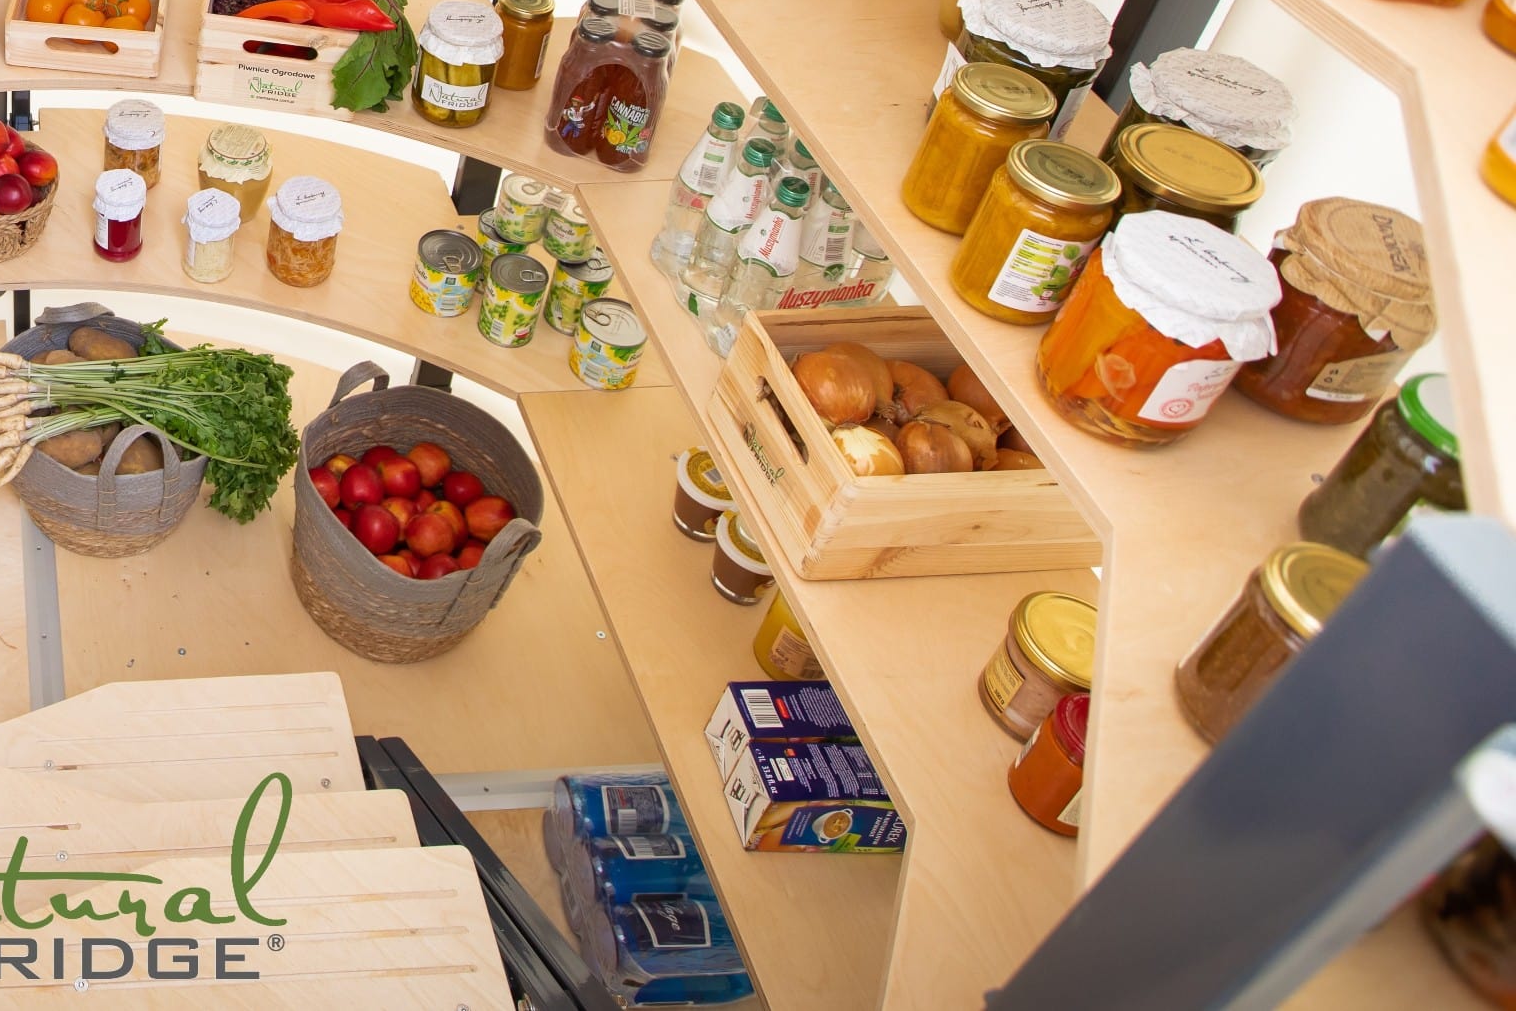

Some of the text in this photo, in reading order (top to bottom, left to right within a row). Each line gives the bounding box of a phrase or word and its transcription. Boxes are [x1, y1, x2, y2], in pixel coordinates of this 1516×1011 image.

[238, 63, 316, 80] Piwnice Ogrodowe
[250, 77, 303, 94] Natural
[261, 89, 297, 98] FRIDGE
[429, 84, 487, 102] Natural
[441, 99, 481, 108] FRIDGE
[610, 95, 650, 124] CANNABIS
[758, 216, 785, 260] Muszynianka
[778, 278, 876, 310] Muszynianka
